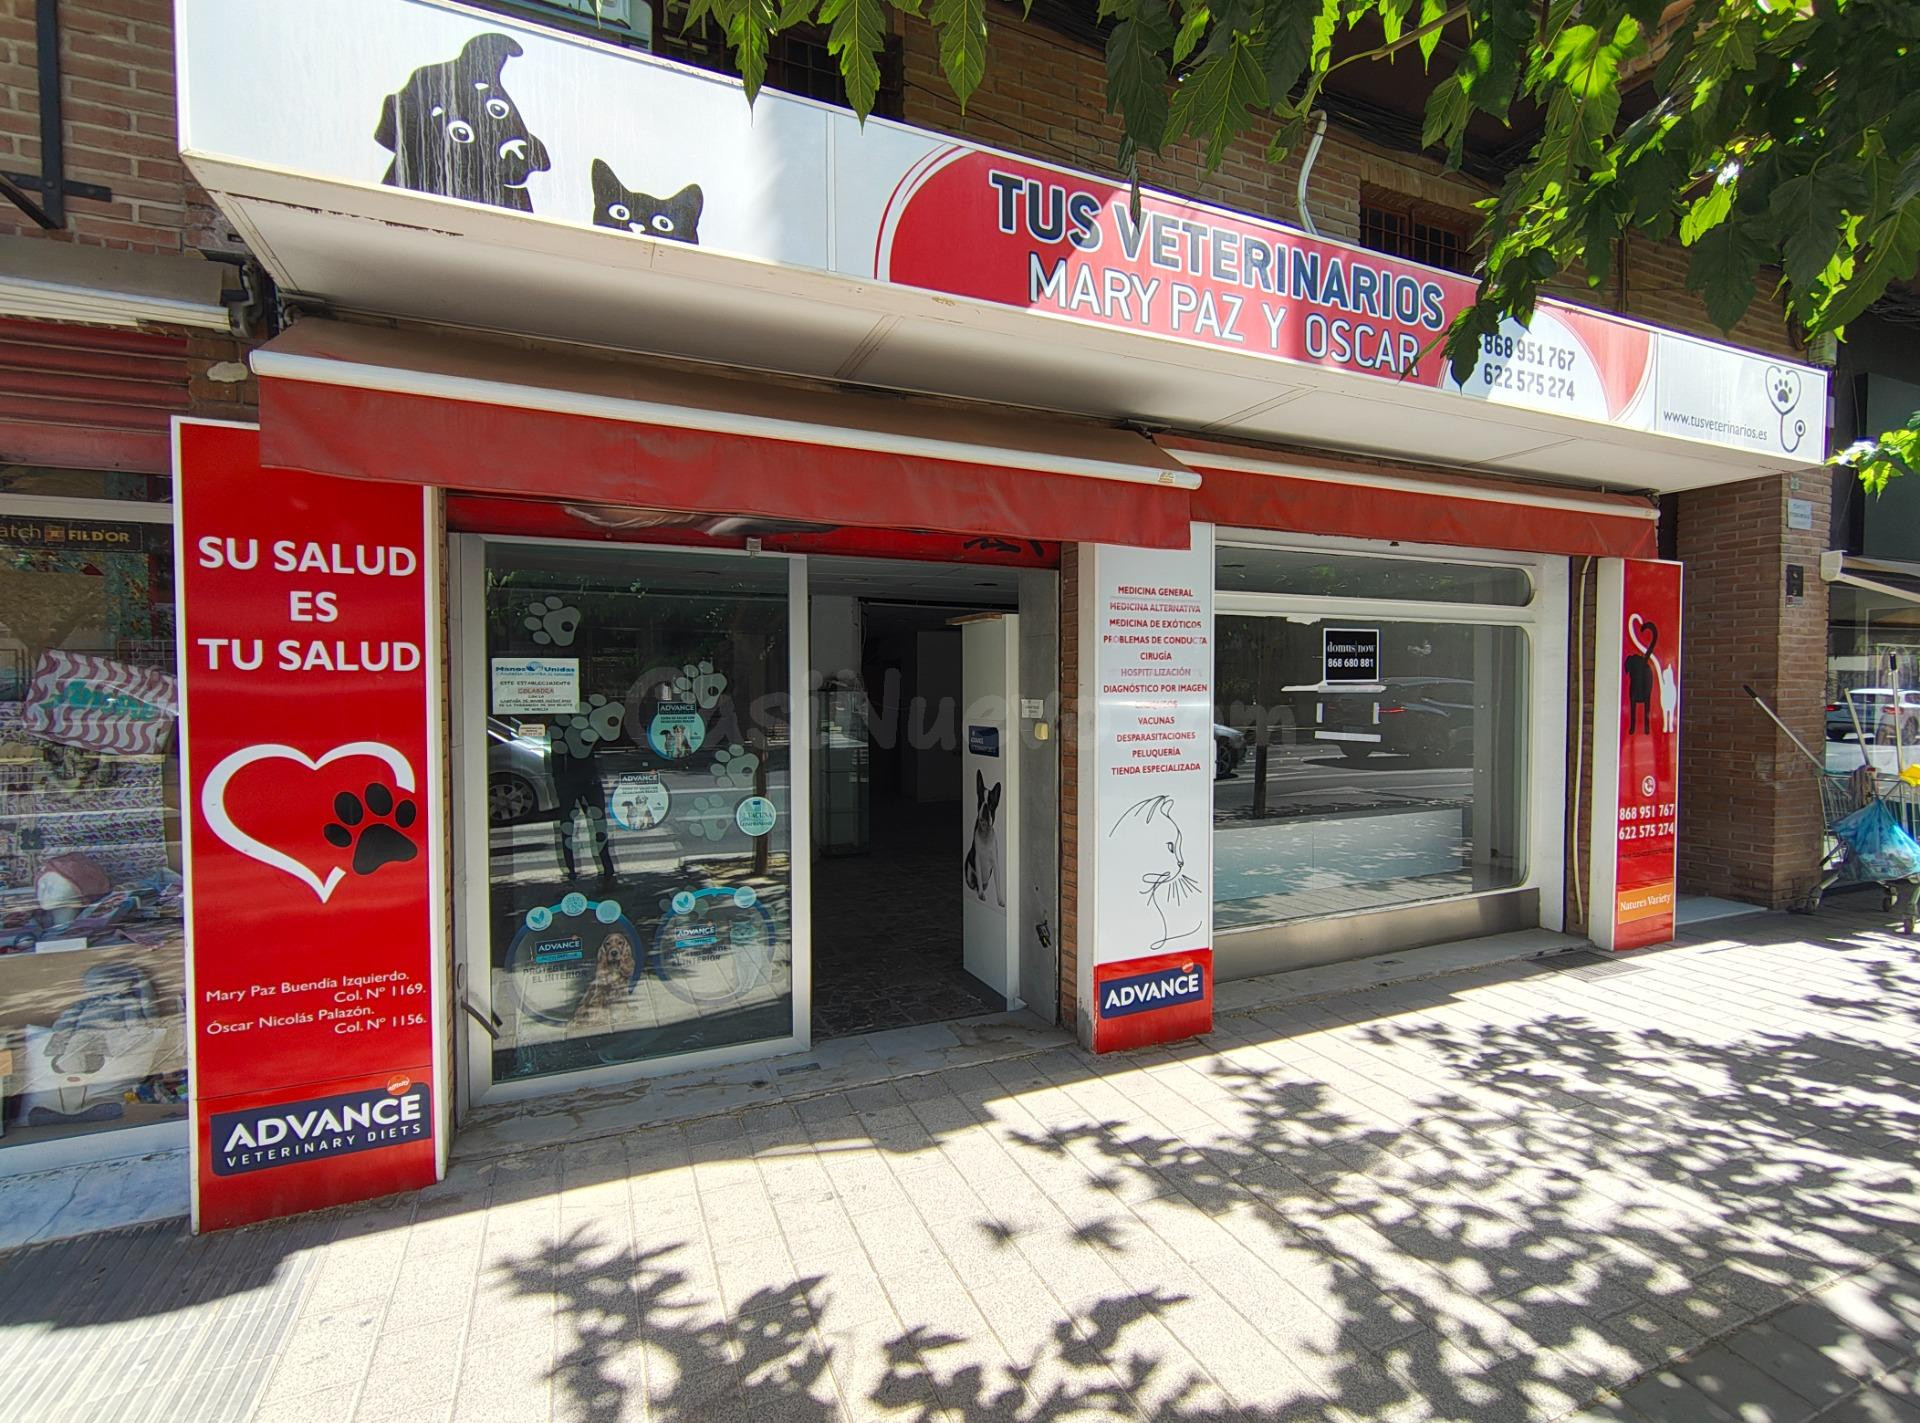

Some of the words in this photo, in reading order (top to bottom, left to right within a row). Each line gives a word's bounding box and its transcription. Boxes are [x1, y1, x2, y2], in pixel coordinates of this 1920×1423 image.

[989, 169, 1102, 252] TUS
[1112, 201, 1445, 332] VETERINARIOS
[1029, 250, 1159, 325] MARY
[1171, 281, 1245, 343] PAZ
[1262, 302, 1288, 350] Y
[1305, 312, 1420, 378] OSCAR
[1484, 333, 1513, 358] 868
[1517, 339, 1544, 366] 951
[1548, 346, 1575, 371] 767
[1484, 363, 1512, 389] 622
[1517, 369, 1544, 395] 575
[1548, 376, 1575, 401] 274
[1663, 410, 1768, 440] www.tusveterinarios.es
[198, 535, 259, 570] SU
[273, 540, 417, 576] SALUD
[1118, 586, 1157, 595] MEDICINA
[1158, 588, 1194, 597] GENERAL
[289, 590, 338, 622] ES
[1109, 602, 1148, 611] MEDICINA
[1150, 604, 1201, 613] ALTERNATIVA
[1109, 618, 1148, 628] MEDICINA
[1150, 620, 1160, 628] DE
[1162, 618, 1201, 628] EXÓTICOS
[1151, 636, 1161, 644] DE
[197, 638, 264, 670] TU
[278, 639, 421, 672] SALUD
[1140, 650, 1172, 660] CIRUGÍA
[1328, 658, 1342, 668] 868
[1344, 658, 1359, 668] 680
[1360, 658, 1374, 668] 881
[1103, 683, 1158, 693] DIAGNÓSTICO
[1160, 684, 1176, 692] POR
[1178, 684, 1207, 692] IMAGEN
[1138, 716, 1175, 725] VACUNAS
[1116, 731, 1196, 742] DESPARASITACIONES
[1132, 747, 1181, 758] PELUQUERÍA
[1111, 766, 1141, 775] TIENDA
[1142, 763, 1201, 774] ESPECIALIZADA
[1619, 807, 1637, 820] 868
[1640, 805, 1655, 819] 951
[1658, 803, 1675, 817] 767
[1618, 826, 1637, 840] 622
[1639, 824, 1656, 838] 575
[1658, 822, 1674, 836] 274
[676, 926, 715, 937] ADVANCE
[538, 940, 580, 952] ADVANCE
[206, 988, 246, 1003] Mary
[251, 985, 276, 996] Paz
[281, 978, 338, 993] Buendía
[343, 970, 409, 988] Izquierdo.
[334, 990, 362, 1003] Col.
[391, 982, 427, 997] 1169.
[1104, 973, 1199, 1010] ADVANCE
[206, 1020, 253, 1035] Óscar
[259, 1012, 314, 1029] Nicolás
[318, 1005, 375, 1021] Palazón.
[334, 1021, 363, 1034] Col.
[391, 1013, 427, 1028] 1156.
[223, 1094, 421, 1153] ADVANCE
[226, 1134, 356, 1168] VETERINARY
[367, 1123, 421, 1142] DIETS
